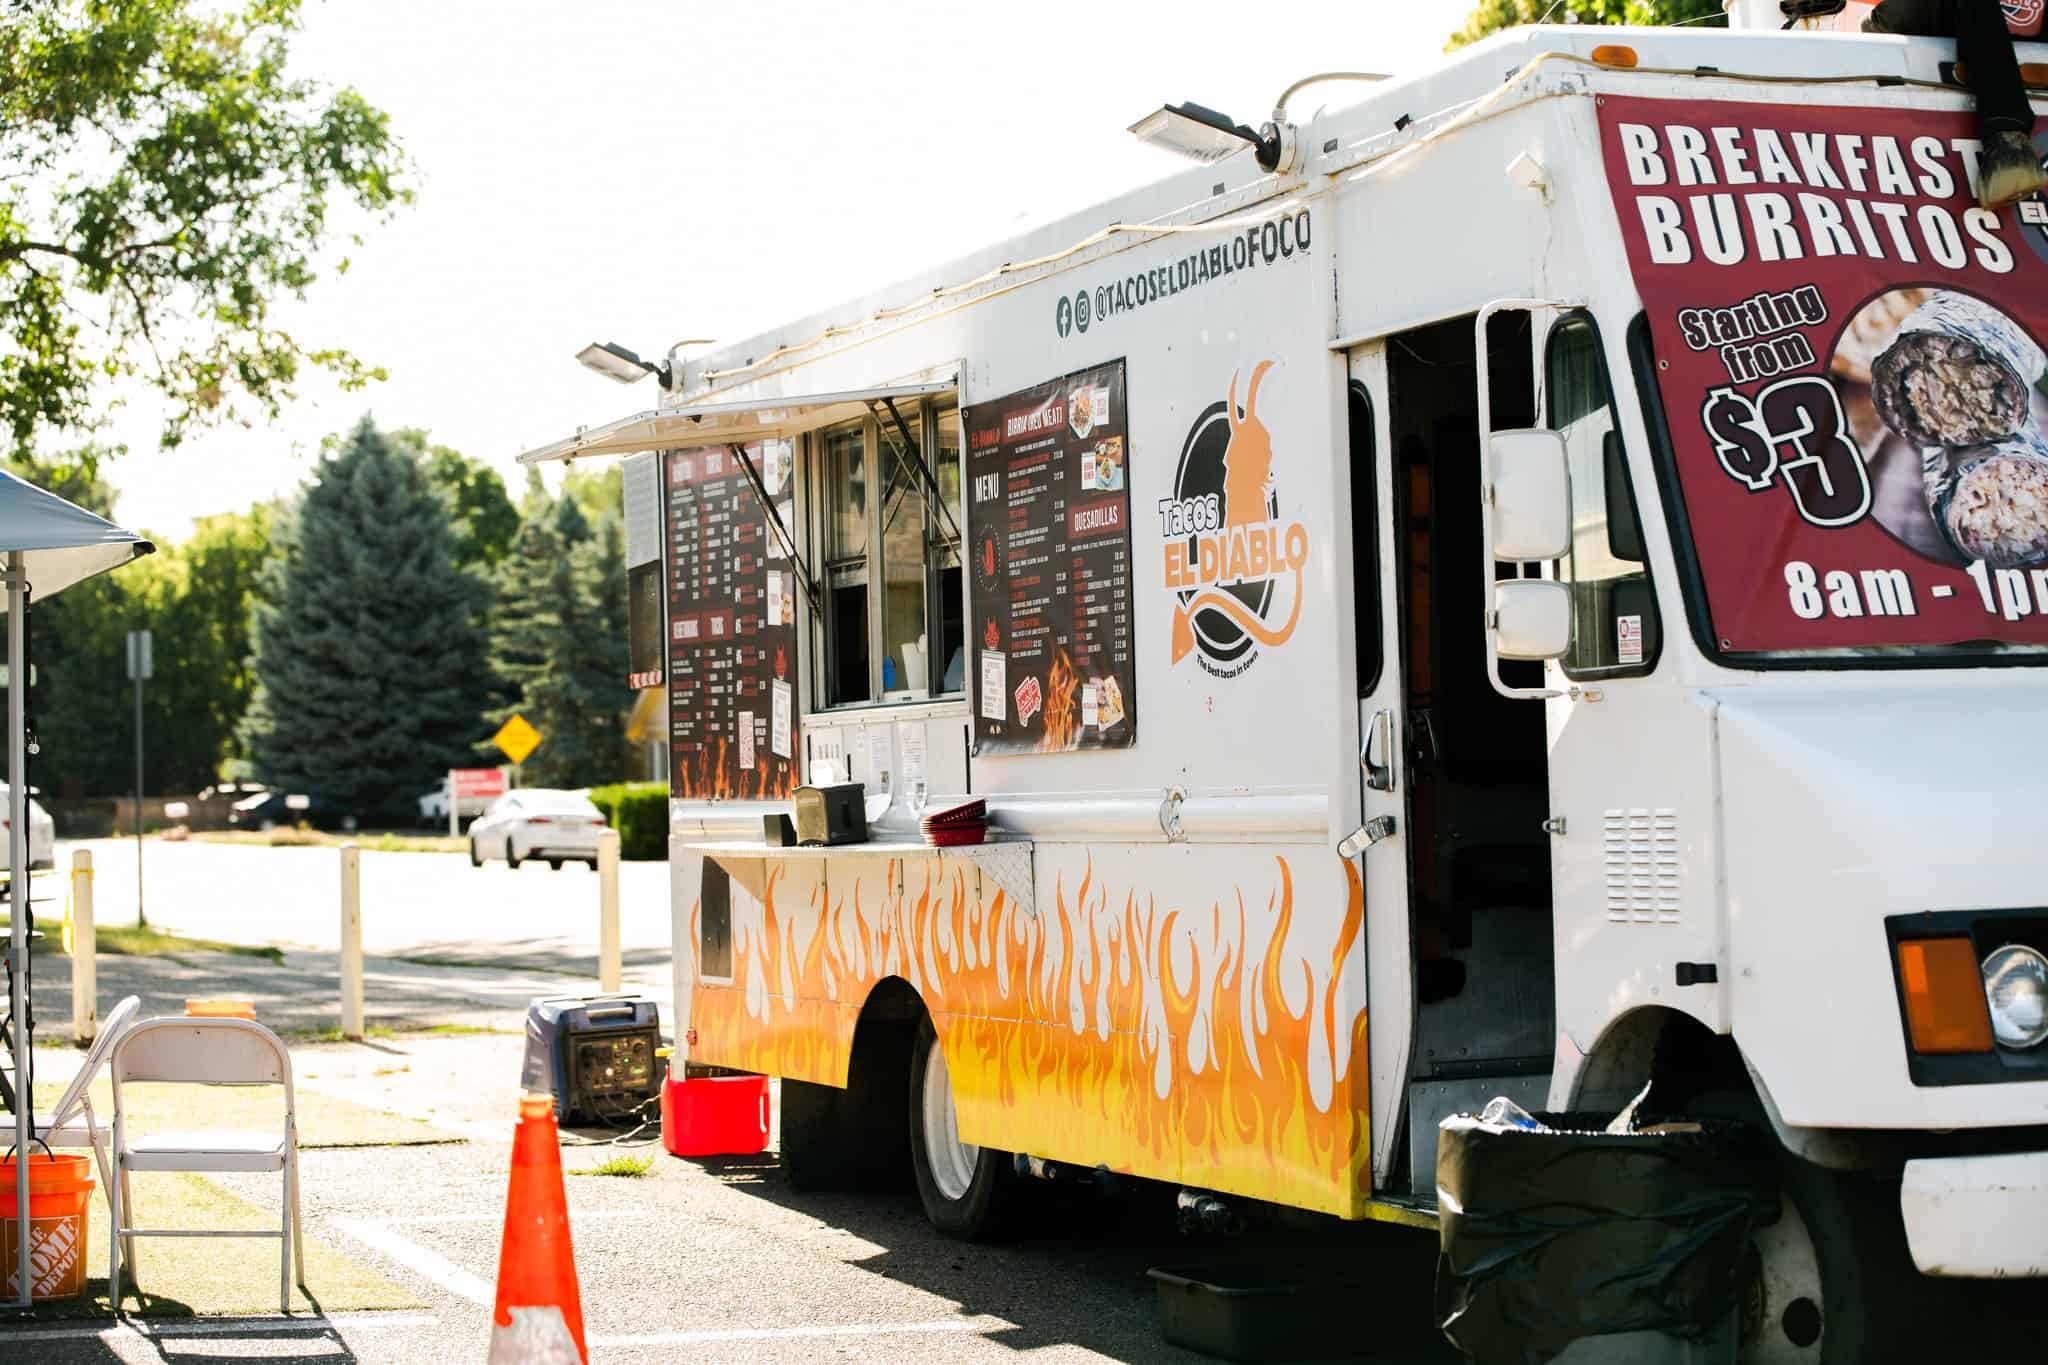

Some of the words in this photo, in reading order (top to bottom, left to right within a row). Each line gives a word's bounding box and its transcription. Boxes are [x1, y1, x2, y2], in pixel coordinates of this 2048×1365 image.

[1618, 122, 1984, 200] BREAKFAST
[1636, 192, 2015, 274] BURRITOS
[1096, 207, 1312, 322] @TACOSELDIABLOFOCO
[1678, 284, 1829, 351] Starting
[1721, 331, 1819, 385] from
[1700, 375, 1874, 528] $3
[975, 472, 999, 504] MENU
[1159, 497, 1218, 536] Tacos
[1074, 504, 1119, 532] QUESADILLAS
[1164, 541, 1196, 588] EL
[1199, 522, 1308, 584] DIABLO
[1784, 561, 1918, 619] 8am
[1197, 653, 1207, 671] The
[1207, 662, 1220, 677] best
[1220, 668, 1237, 679] tacos
[37, 1247, 76, 1296] DEPOT
